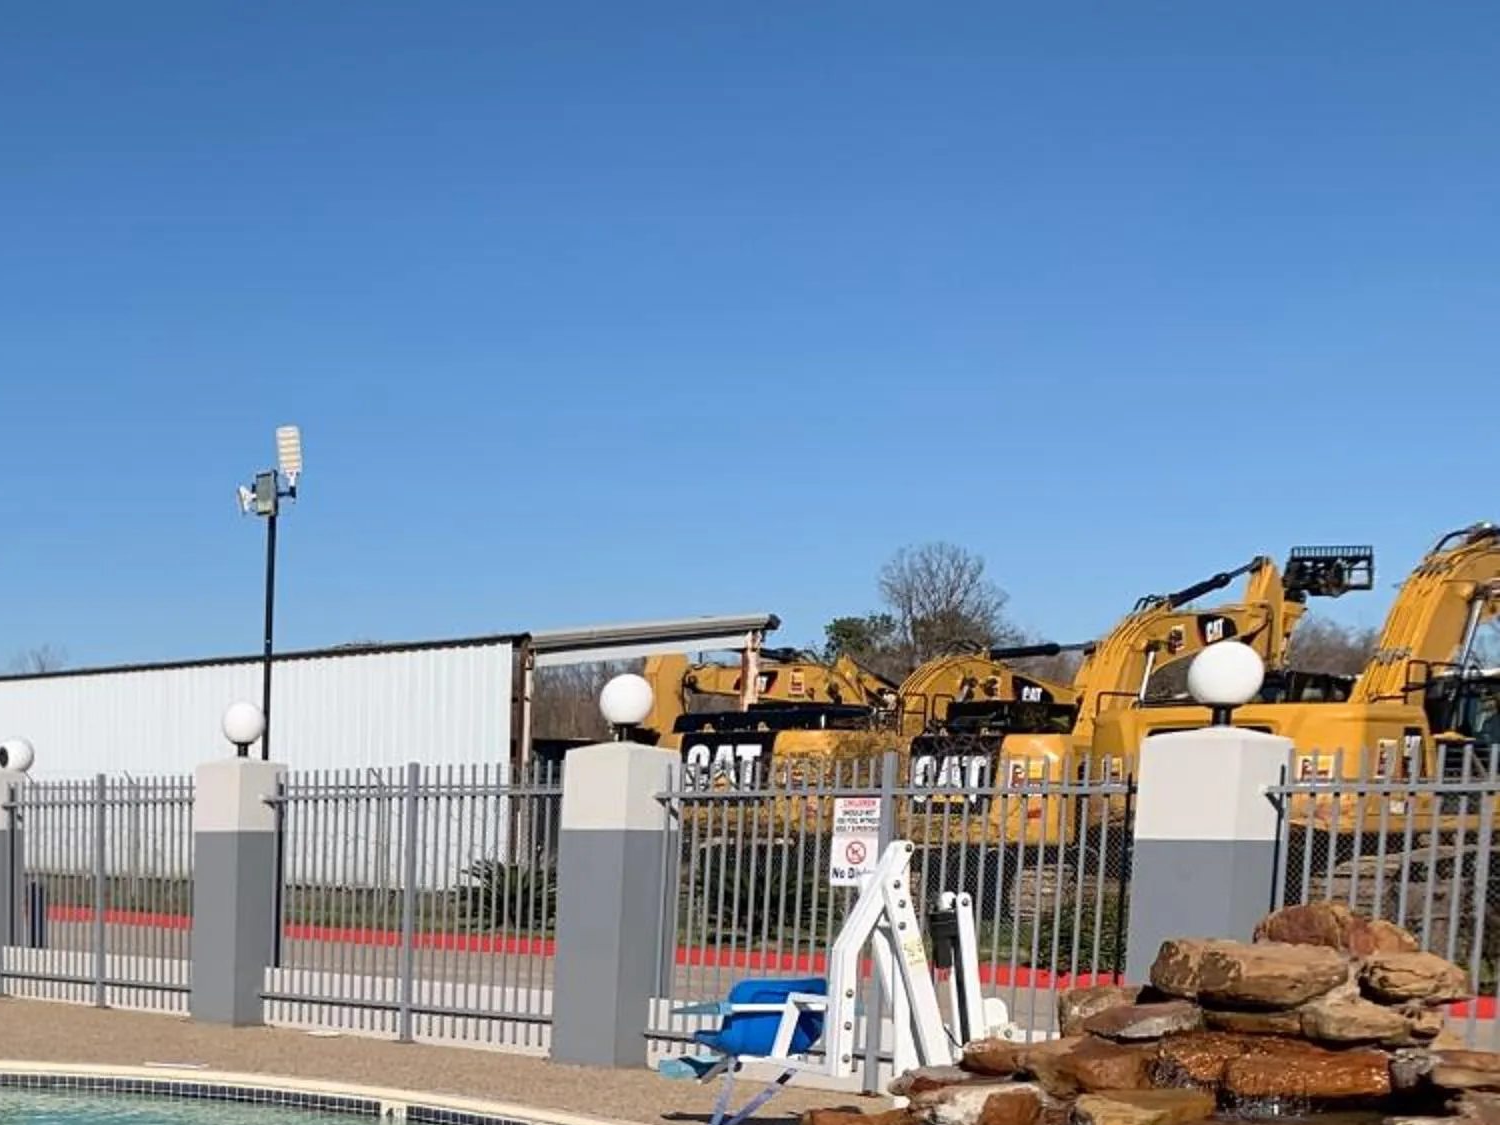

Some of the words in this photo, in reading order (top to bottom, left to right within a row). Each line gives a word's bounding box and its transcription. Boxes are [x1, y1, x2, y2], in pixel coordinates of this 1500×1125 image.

[1206, 618, 1224, 643] CAT
[1022, 685, 1042, 702] CAT
[685, 743, 762, 794] CAT
[913, 755, 987, 802] CAT
[832, 867, 845, 879] No
